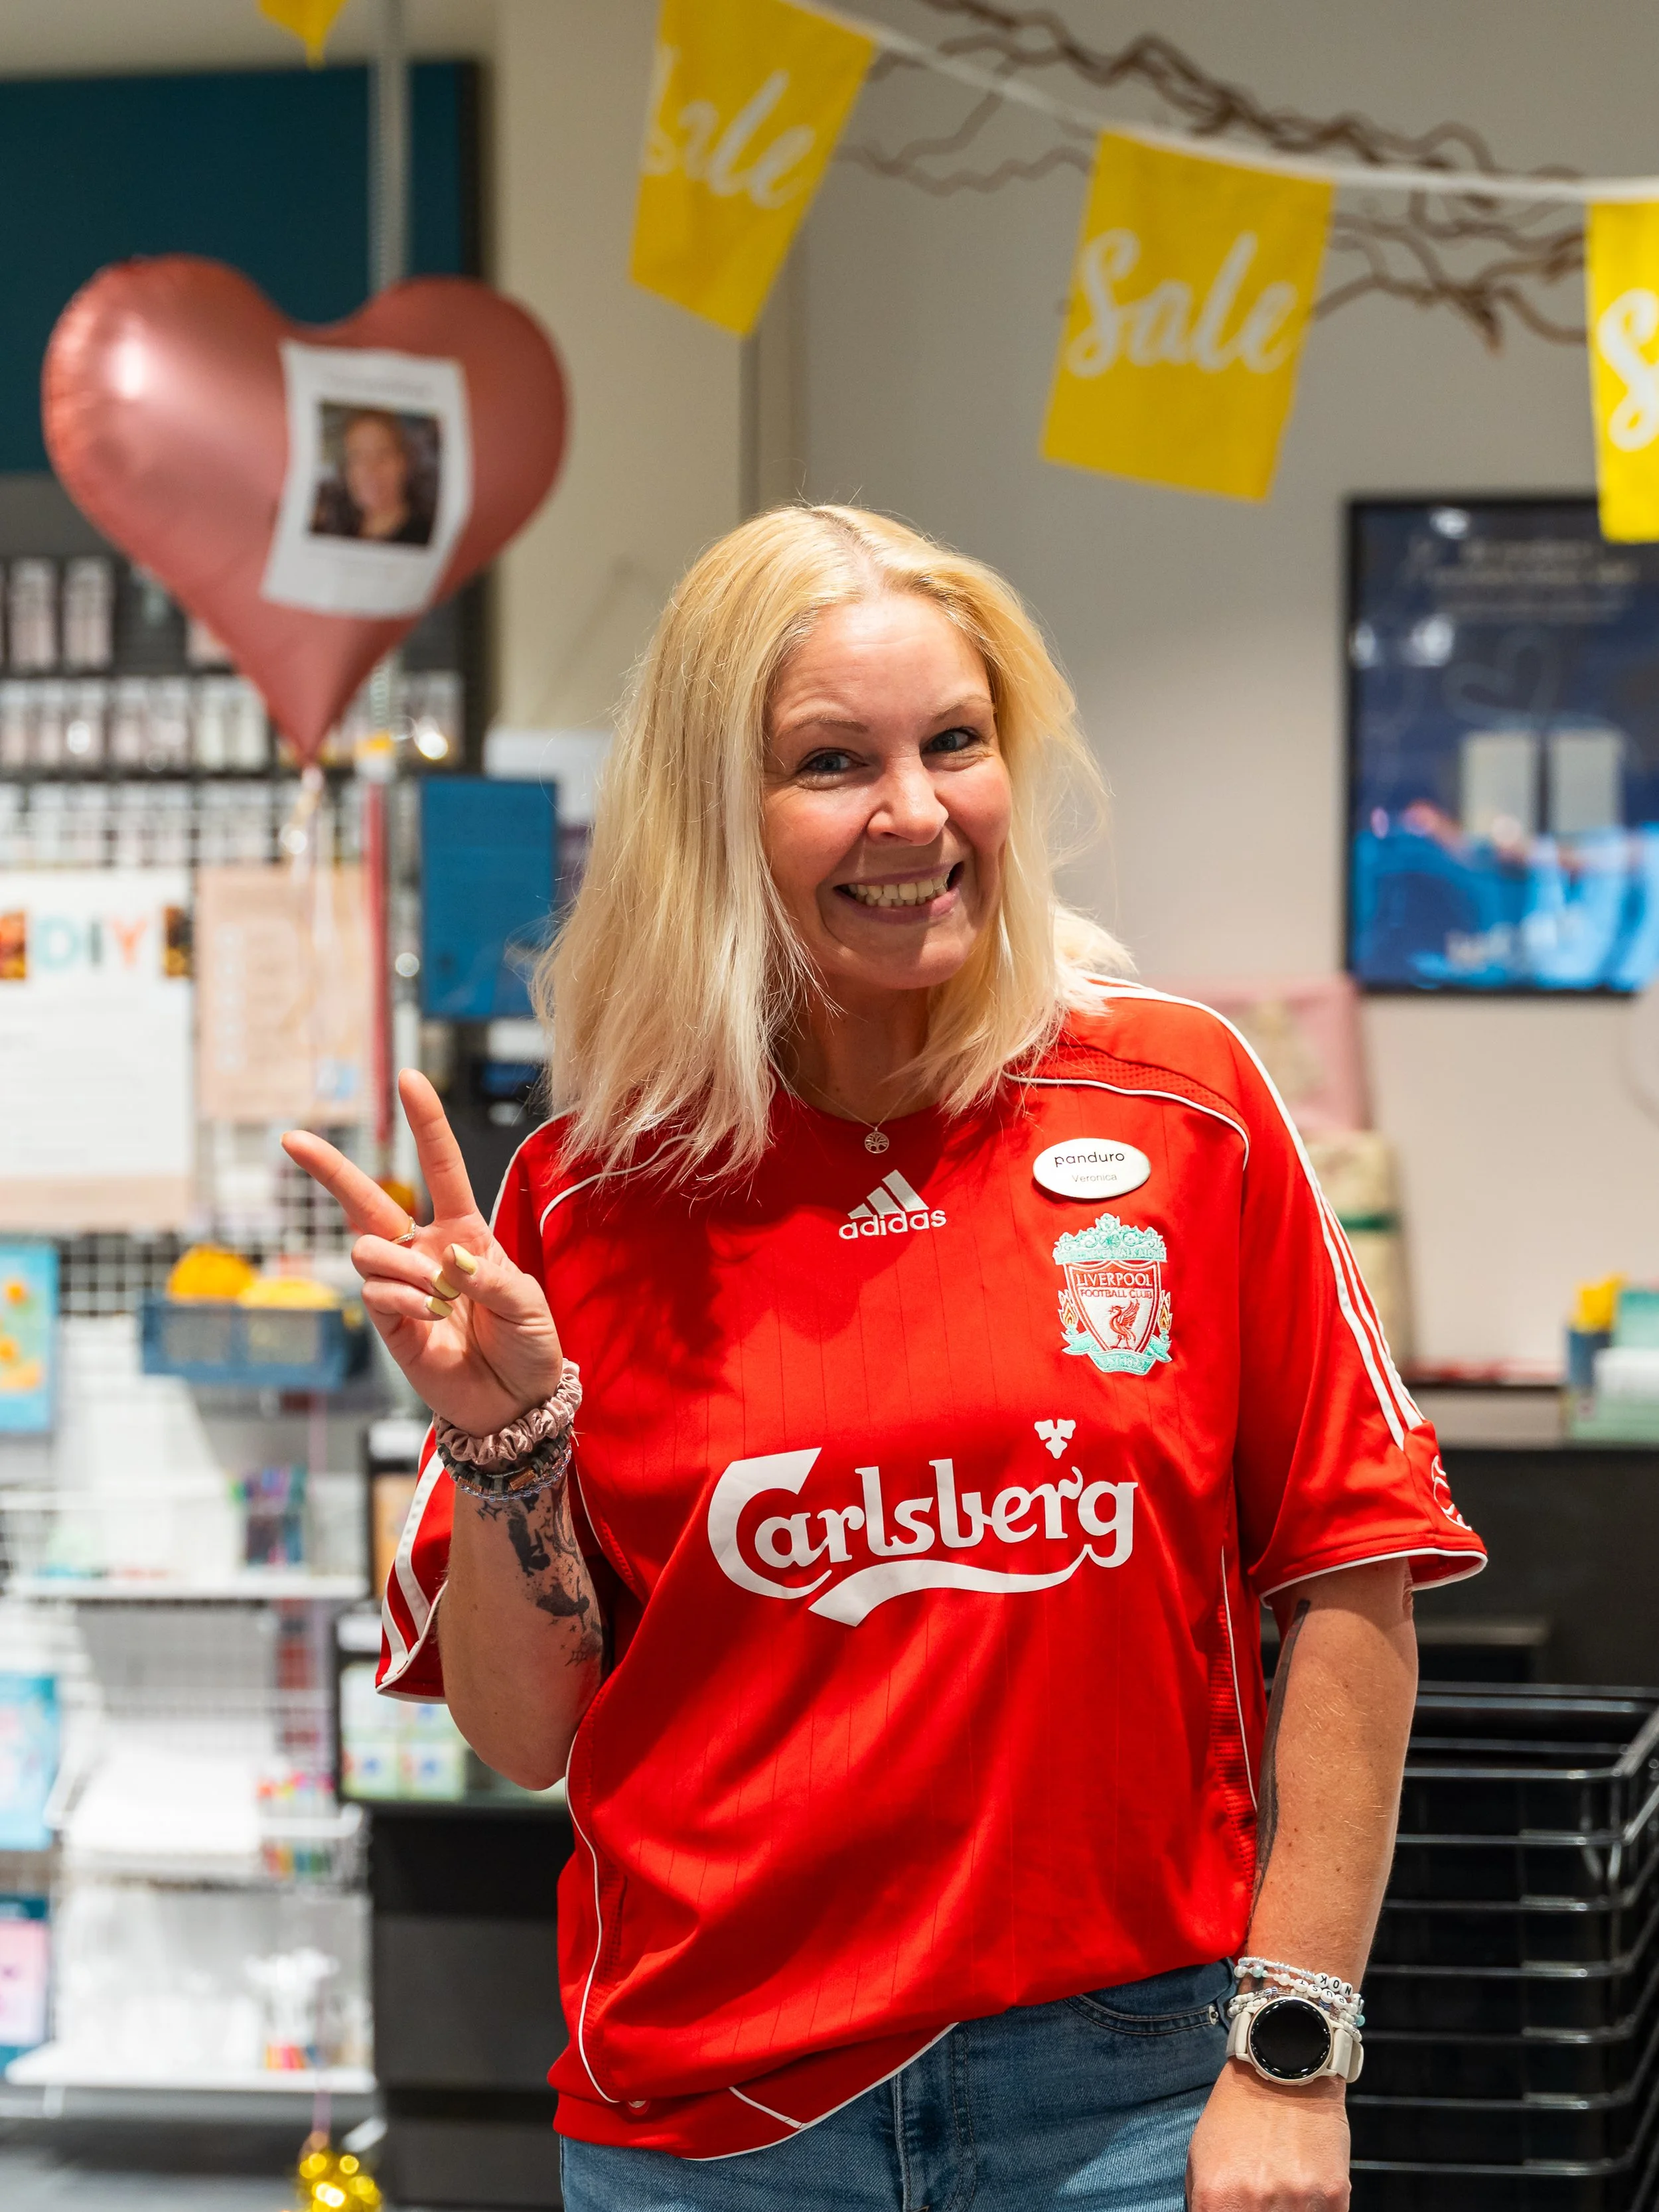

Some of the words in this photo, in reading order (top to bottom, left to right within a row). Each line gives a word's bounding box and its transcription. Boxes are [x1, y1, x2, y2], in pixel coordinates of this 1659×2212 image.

[1066, 227, 1299, 378] Sale
[35, 915, 149, 972] DIY
[1054, 1151, 1125, 1168] panduro
[1071, 1174, 1118, 1183] Veronica
[838, 1209, 947, 1240] adidas
[1076, 1272, 1153, 1286] LIVERPOOL
[1080, 1289, 1127, 1297] FOOTBALL
[1129, 1289, 1153, 1299] CLUB
[707, 1447, 1138, 1627] Carlsberg
